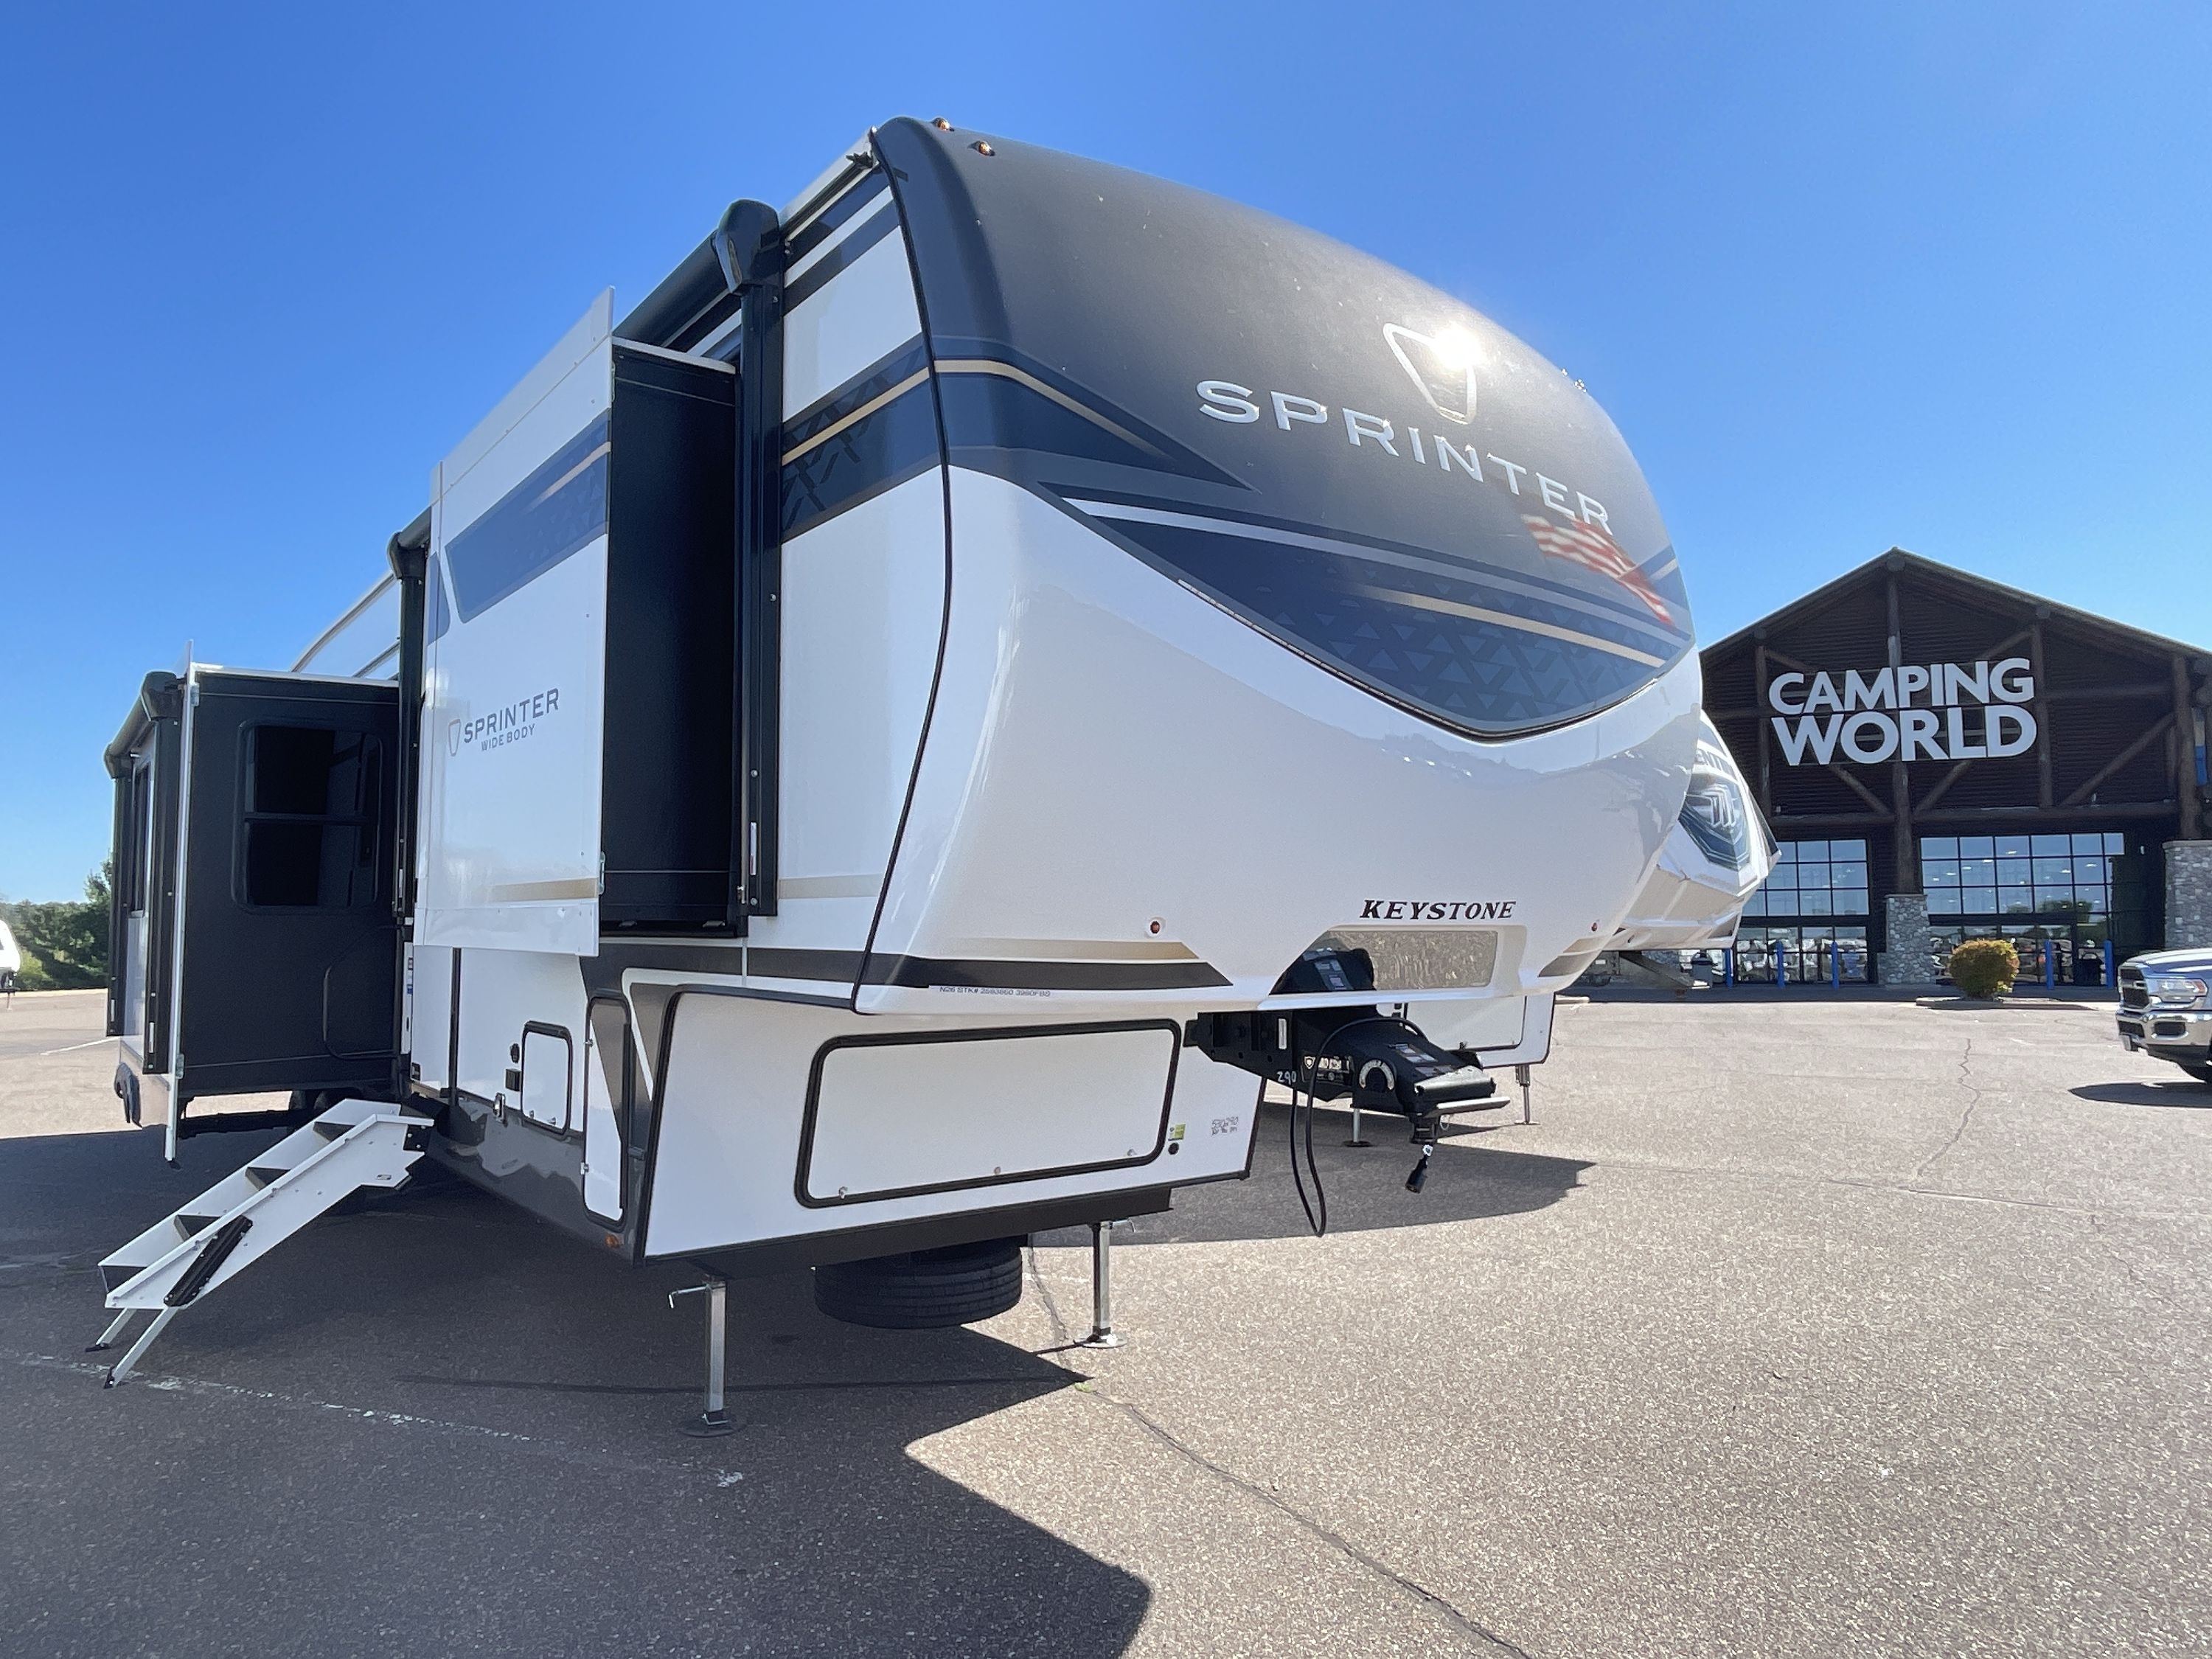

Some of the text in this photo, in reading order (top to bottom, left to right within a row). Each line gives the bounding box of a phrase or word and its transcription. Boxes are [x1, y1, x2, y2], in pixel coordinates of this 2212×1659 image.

[1196, 380, 1613, 535] SPRINTER
[1769, 658, 2034, 714] CAMPING
[465, 688, 559, 743] SPRINTER
[1771, 705, 2037, 766] WORLD
[1360, 900, 1517, 920] KEYSTONE
[1277, 1071, 1297, 1085] 290
